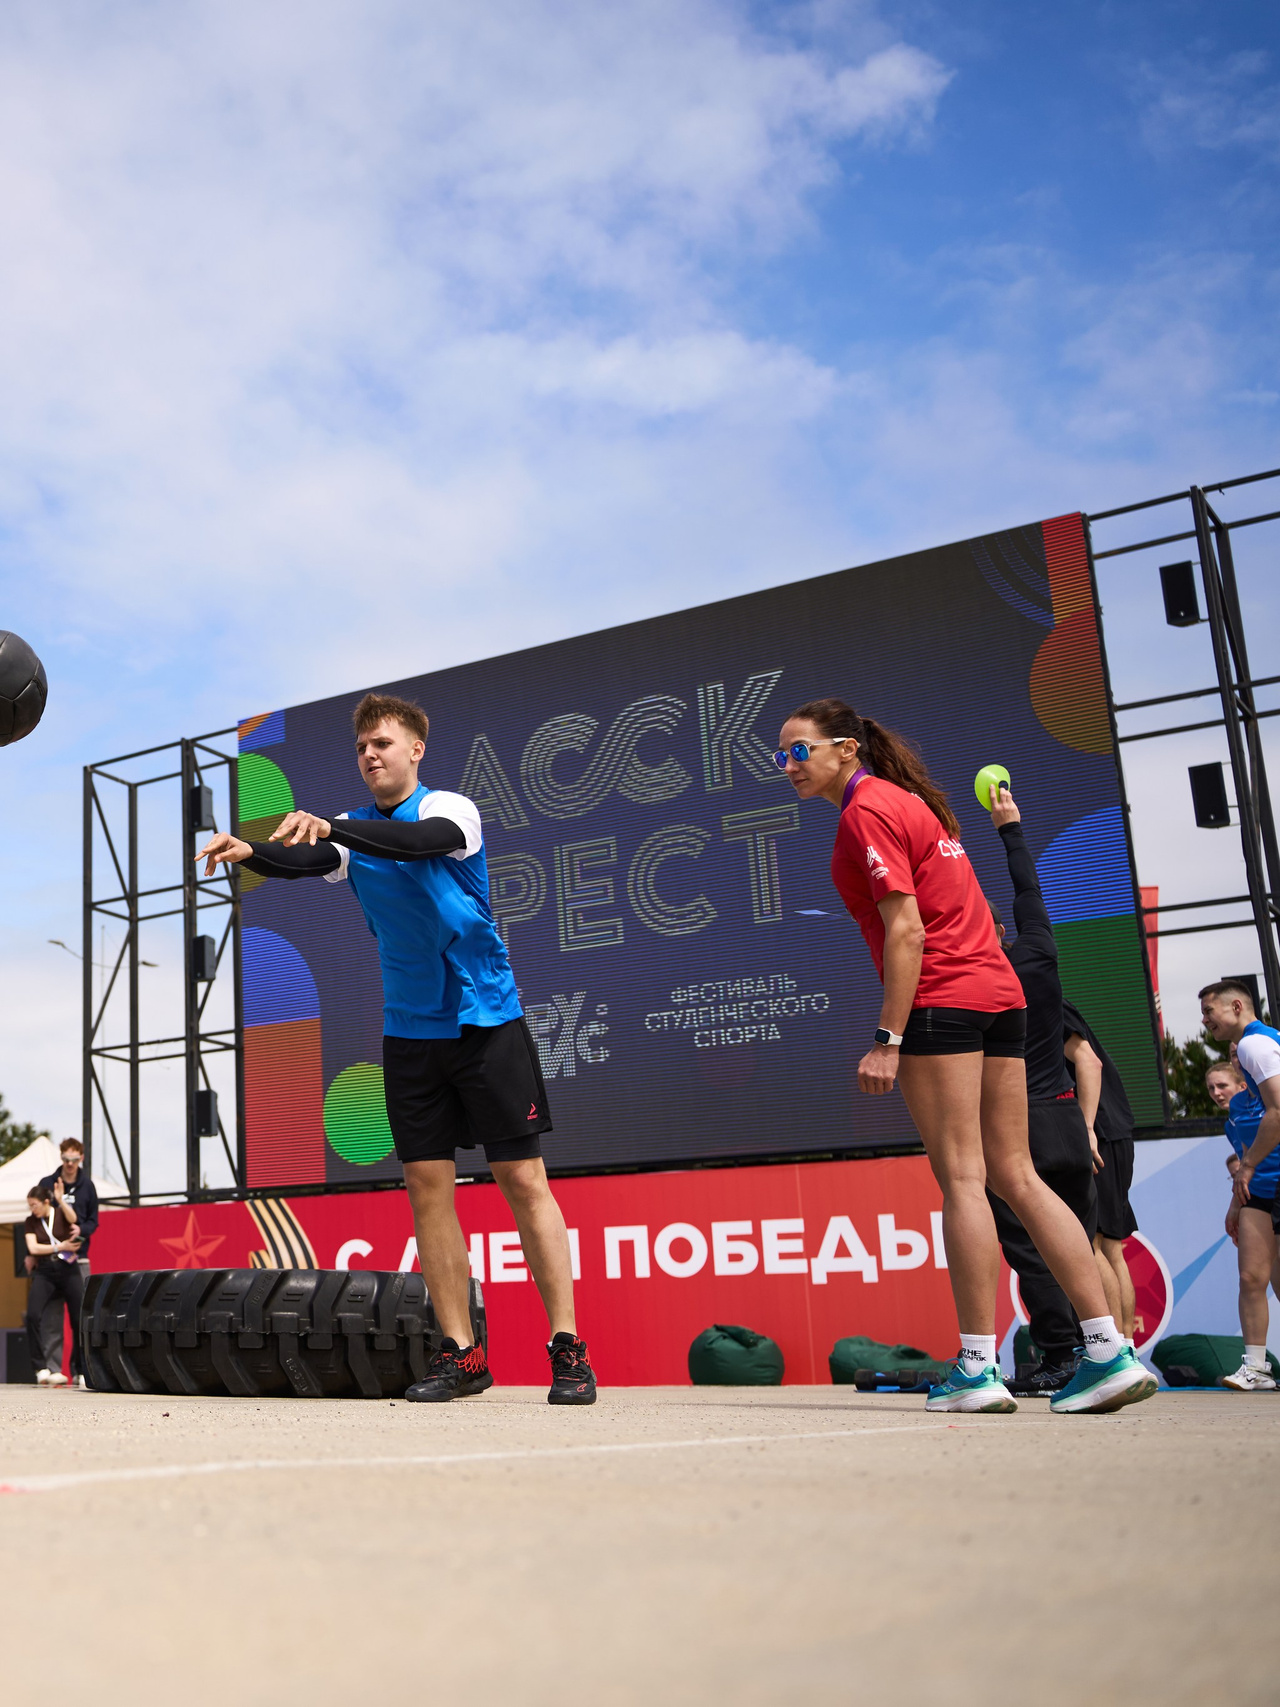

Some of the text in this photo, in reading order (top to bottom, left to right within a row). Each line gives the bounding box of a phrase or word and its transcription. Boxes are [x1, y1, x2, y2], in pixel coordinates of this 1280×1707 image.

[457, 667, 788, 830] АССК
[671, 973, 797, 1005] ФЕСТИВАЛЬ
[645, 993, 829, 1032] СТУДЕНЧЕСКОГО
[694, 1023, 781, 1048] СПОРТА
[604, 1211, 949, 1285] ПОБЕДЫ
